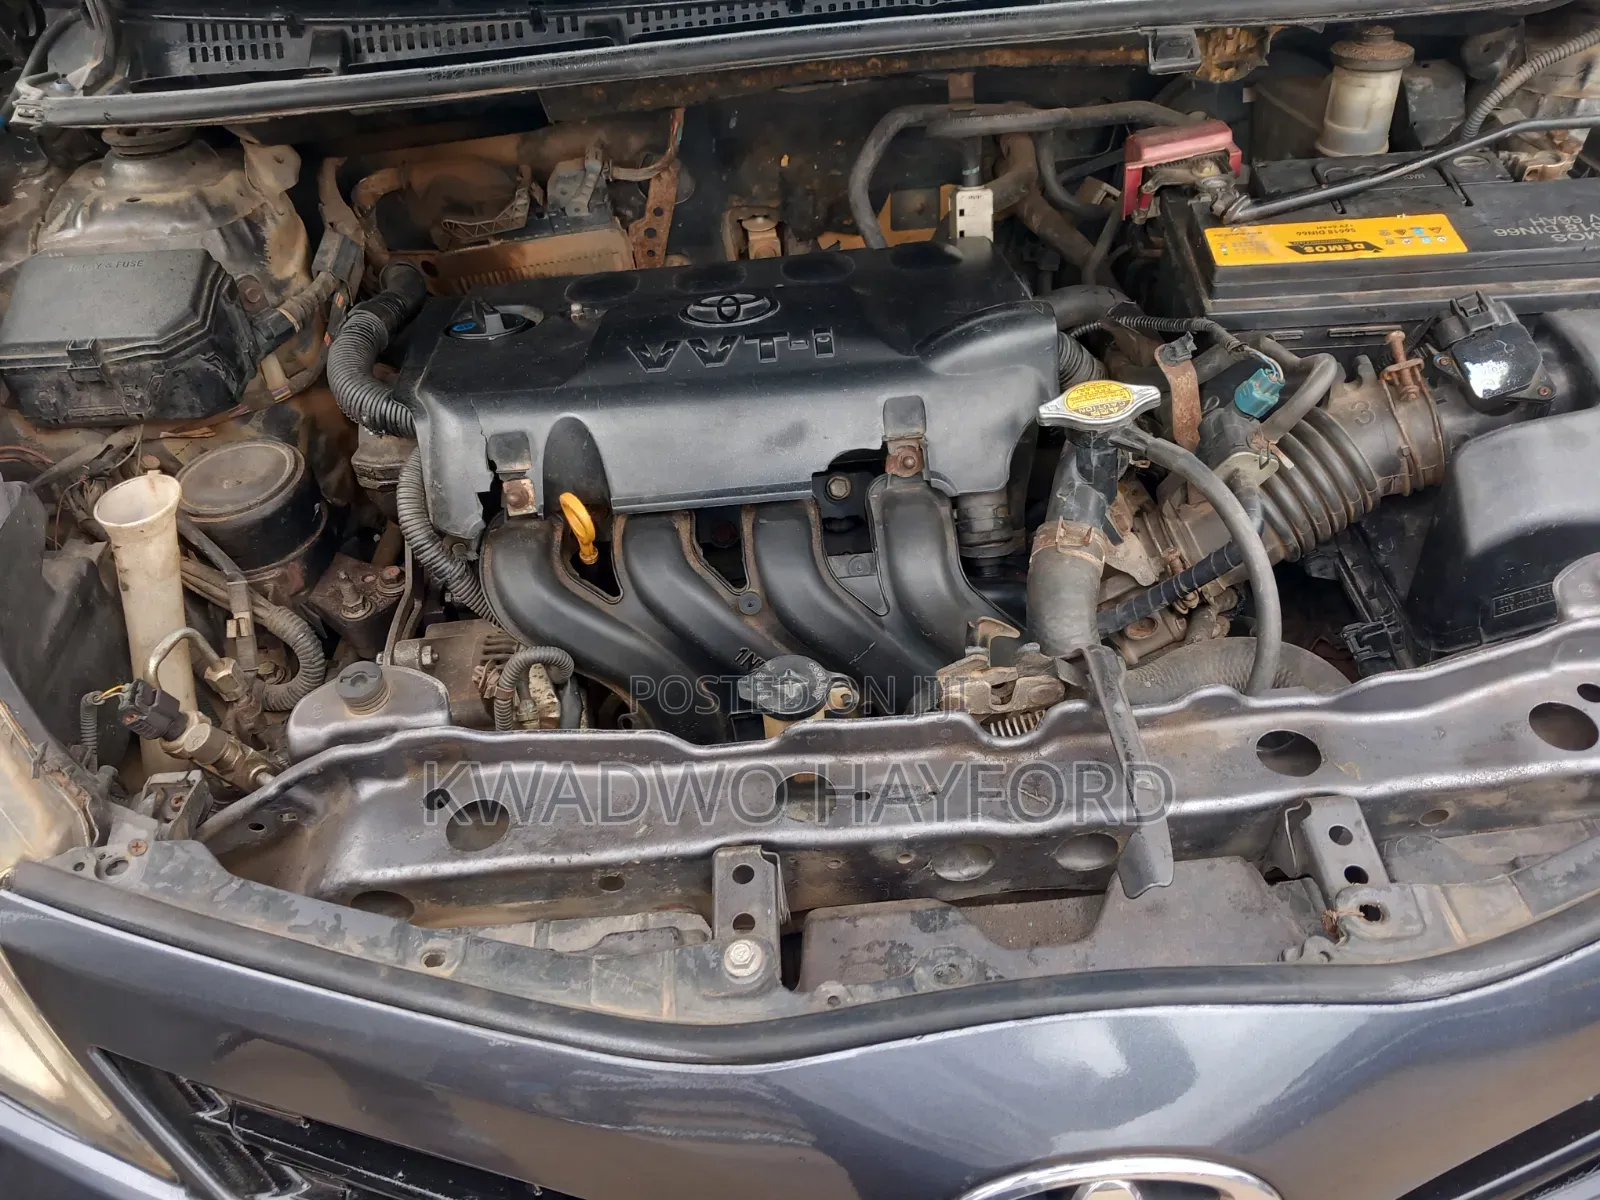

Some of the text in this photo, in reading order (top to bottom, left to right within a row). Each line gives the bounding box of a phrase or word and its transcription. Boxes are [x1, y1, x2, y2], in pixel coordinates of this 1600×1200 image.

[1529, 215, 1582, 227] 66AH
[1493, 225, 1561, 237] DIN66
[1551, 231, 1600, 243] MOS
[1303, 243, 1366, 253] DEMOS
[115, 260, 144, 268] FUSE
[1078, 401, 1126, 414] CAUTION
